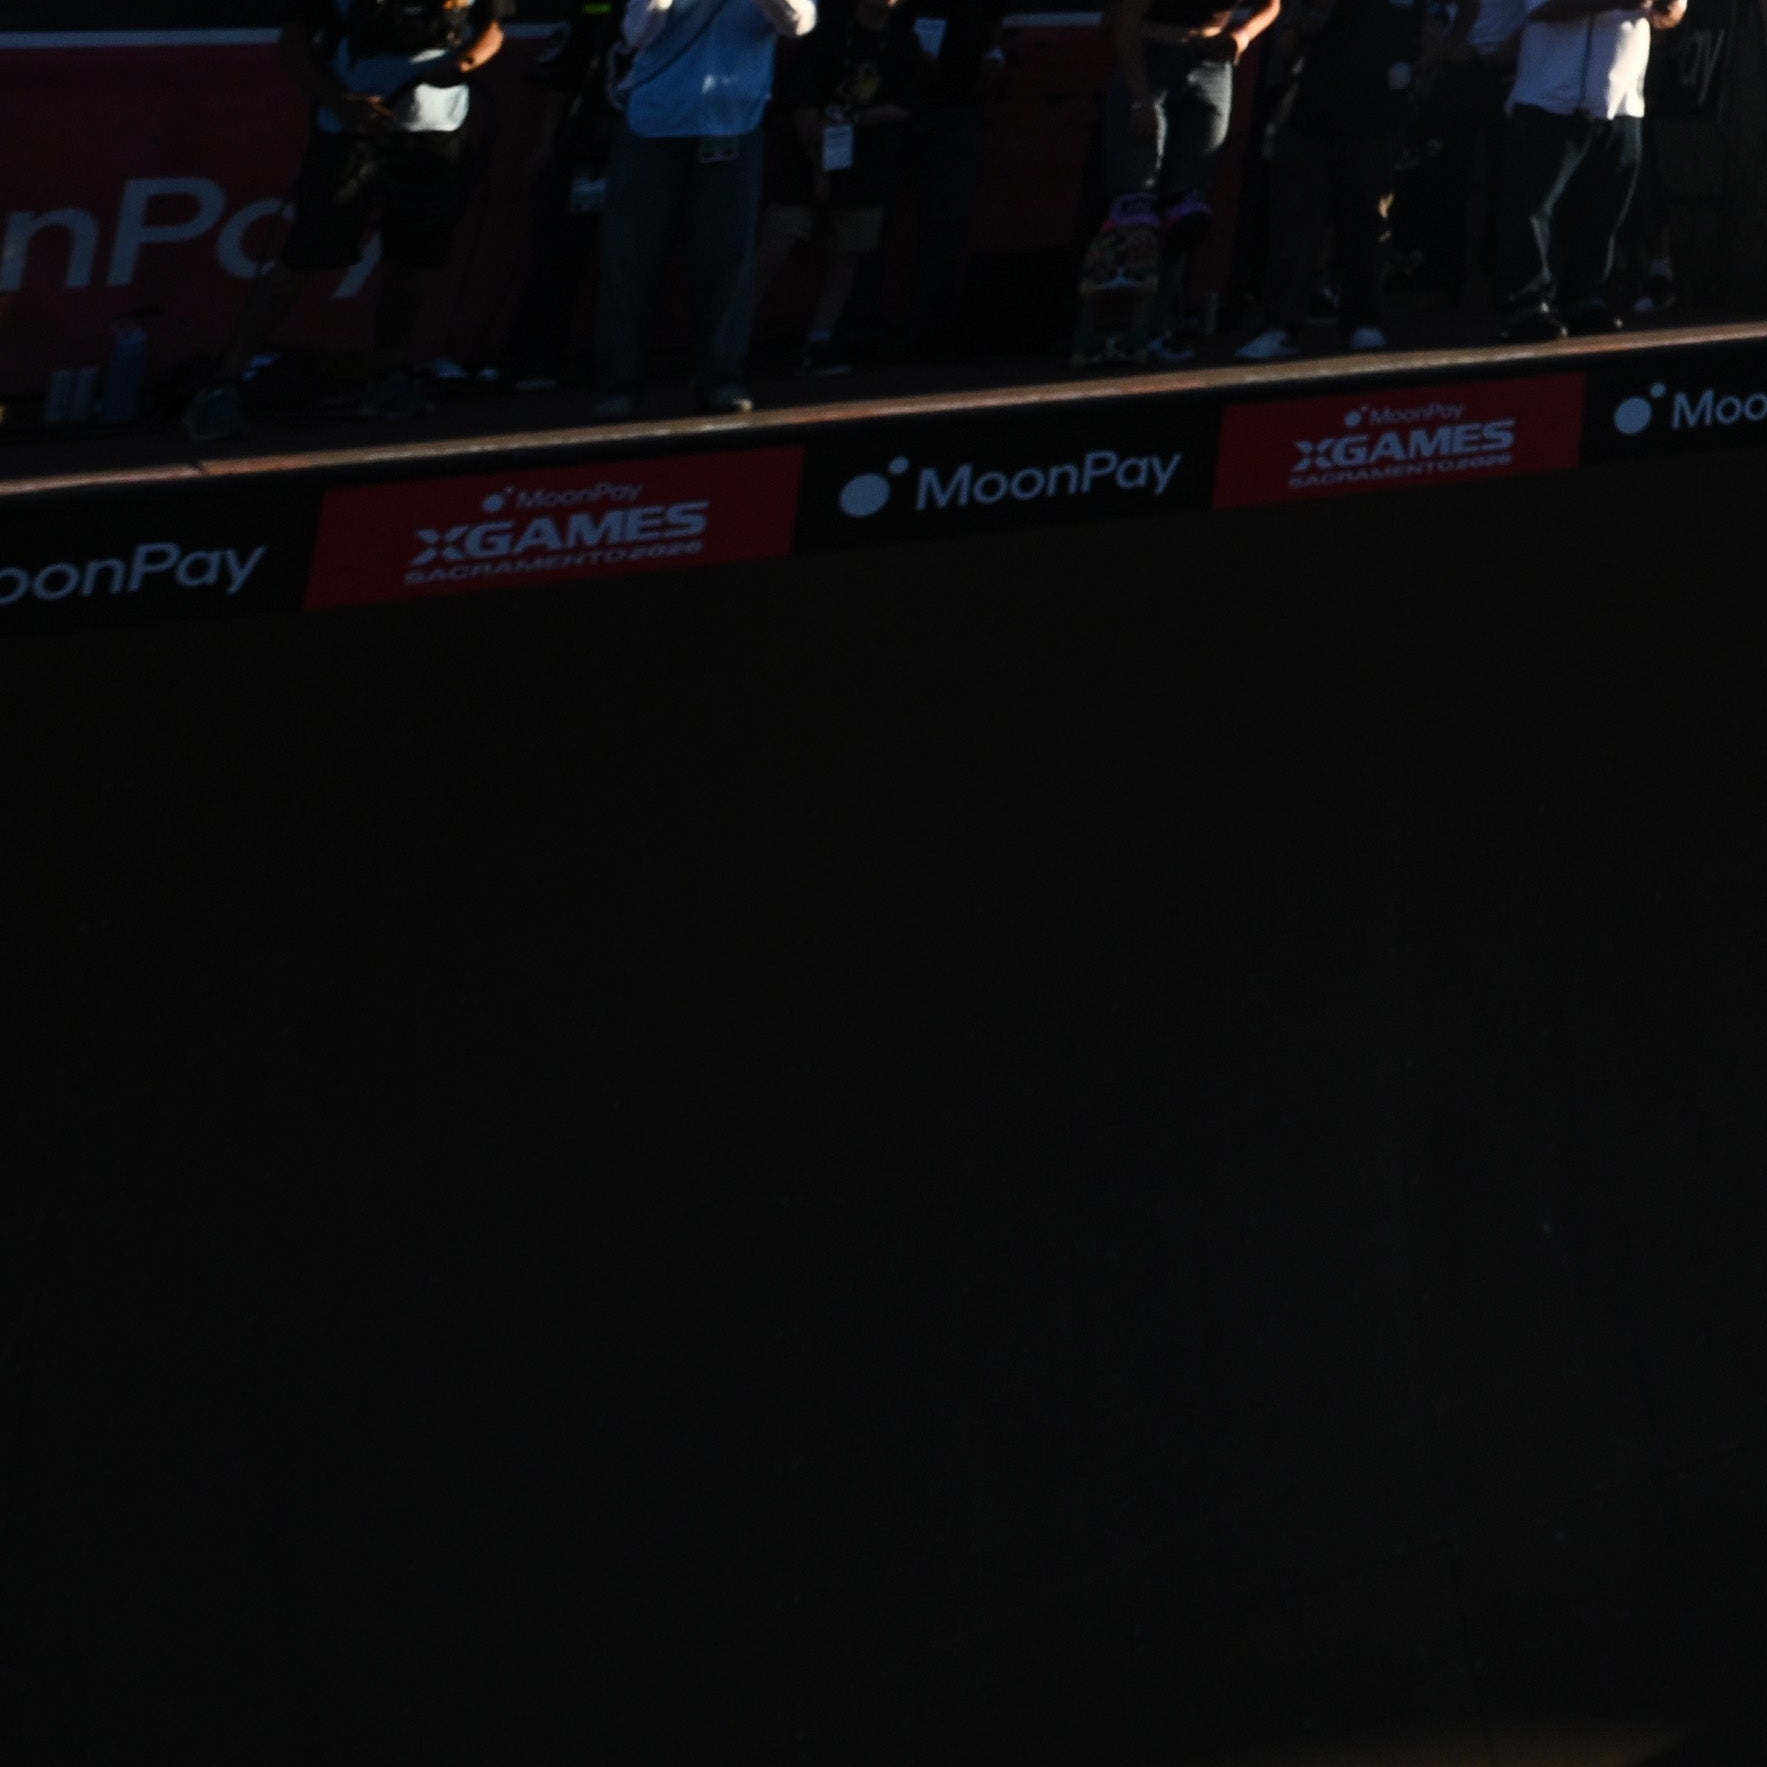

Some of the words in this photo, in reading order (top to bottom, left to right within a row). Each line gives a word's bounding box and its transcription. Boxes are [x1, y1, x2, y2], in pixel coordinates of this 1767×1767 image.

[1368, 401, 1466, 425] MoonPay
[914, 447, 1185, 512] MoonPay
[514, 480, 646, 511] MoonPay
